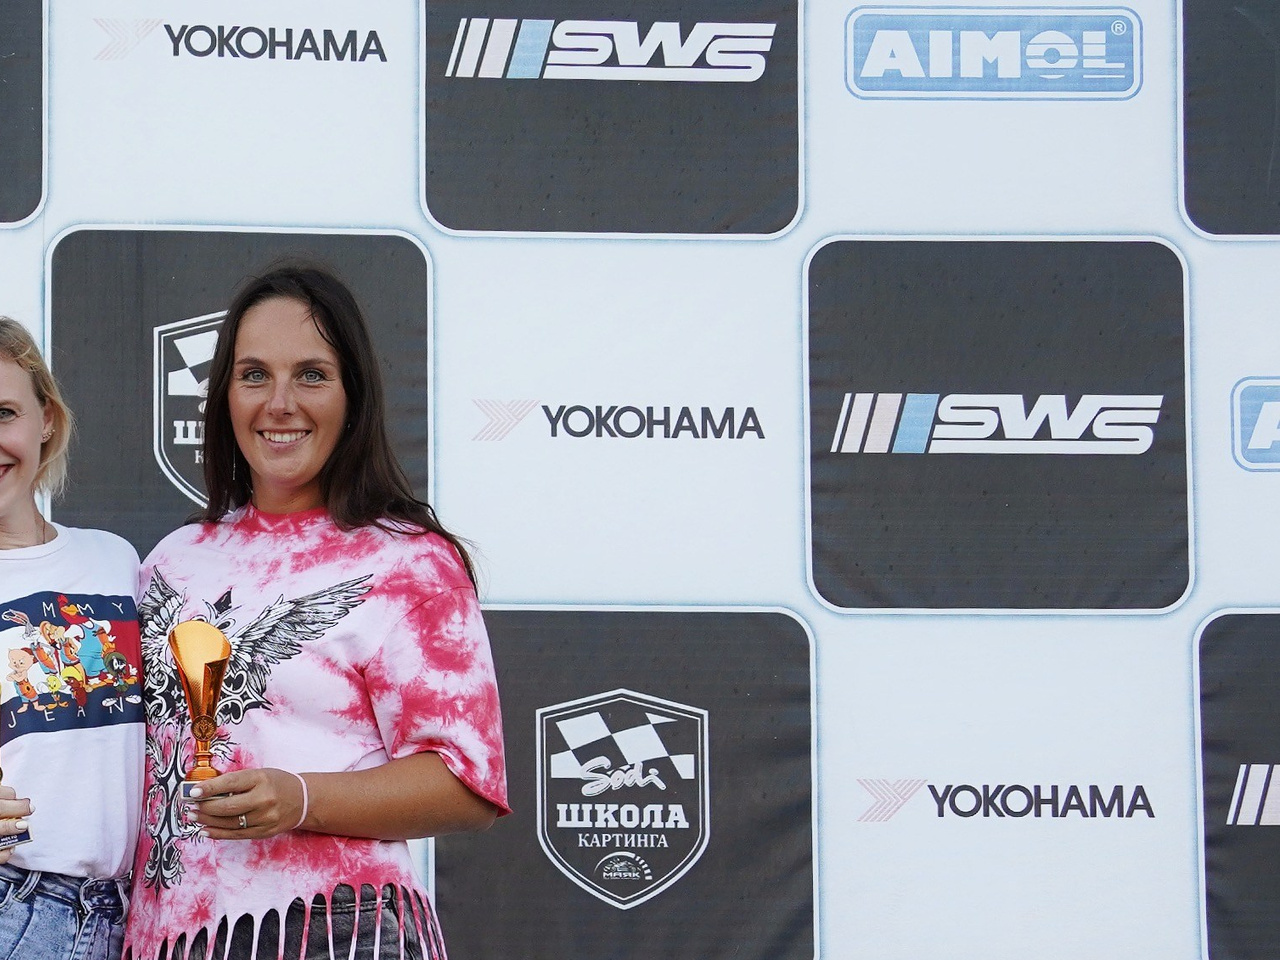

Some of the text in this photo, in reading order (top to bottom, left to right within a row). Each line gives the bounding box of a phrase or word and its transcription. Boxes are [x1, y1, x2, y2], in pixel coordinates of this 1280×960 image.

[164, 25, 387, 62] YOKOHAMA
[543, 20, 776, 82] SWS
[541, 405, 766, 440] YOKOHAMA
[931, 394, 1164, 455] SWS
[581, 755, 667, 797] Sodi
[556, 803, 690, 829] ШКОЛА
[927, 784, 1156, 819] YOKOHAMA
[578, 833, 669, 848] КАРТИНГА
